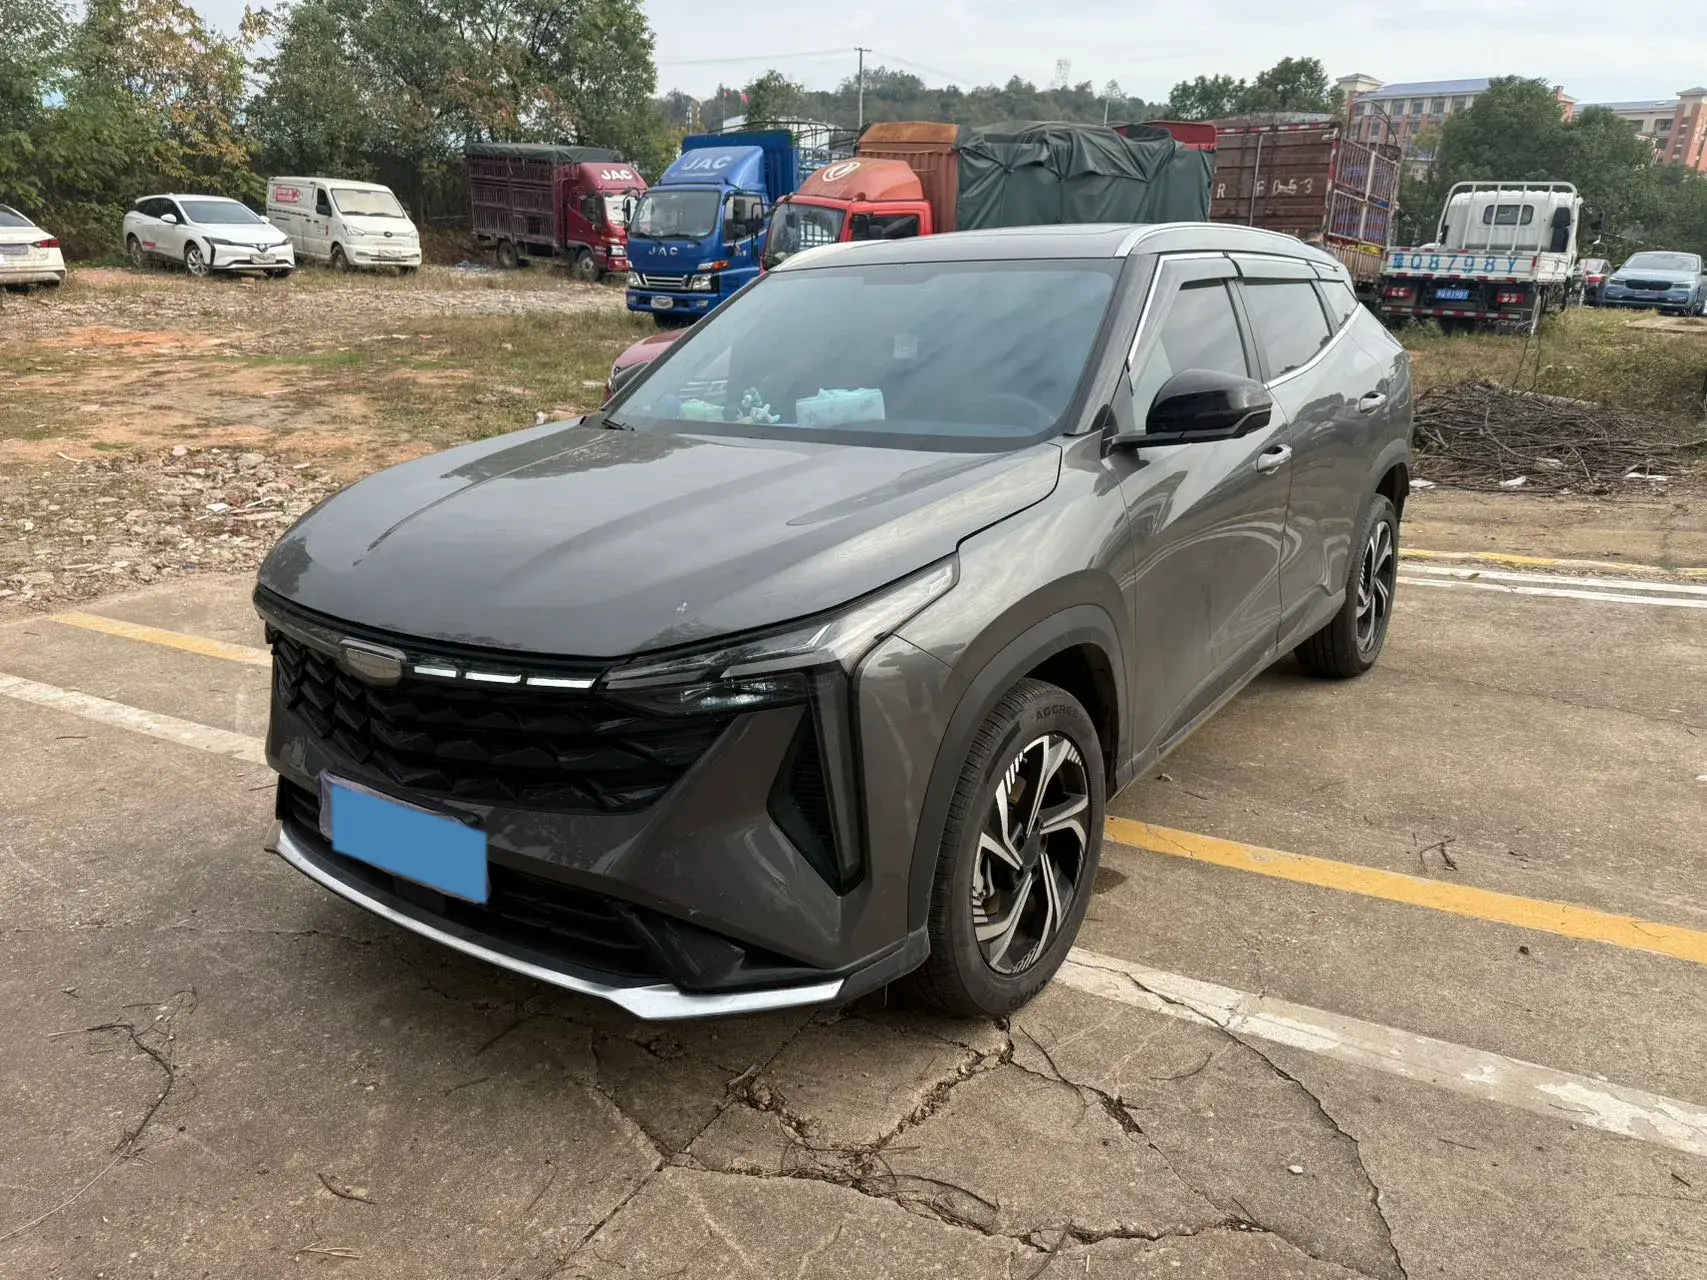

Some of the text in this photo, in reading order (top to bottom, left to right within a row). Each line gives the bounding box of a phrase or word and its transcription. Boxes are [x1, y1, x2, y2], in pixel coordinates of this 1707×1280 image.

[681, 156, 732, 170] JAC
[601, 169, 633, 181] JAC
[648, 246, 679, 257] JAC
